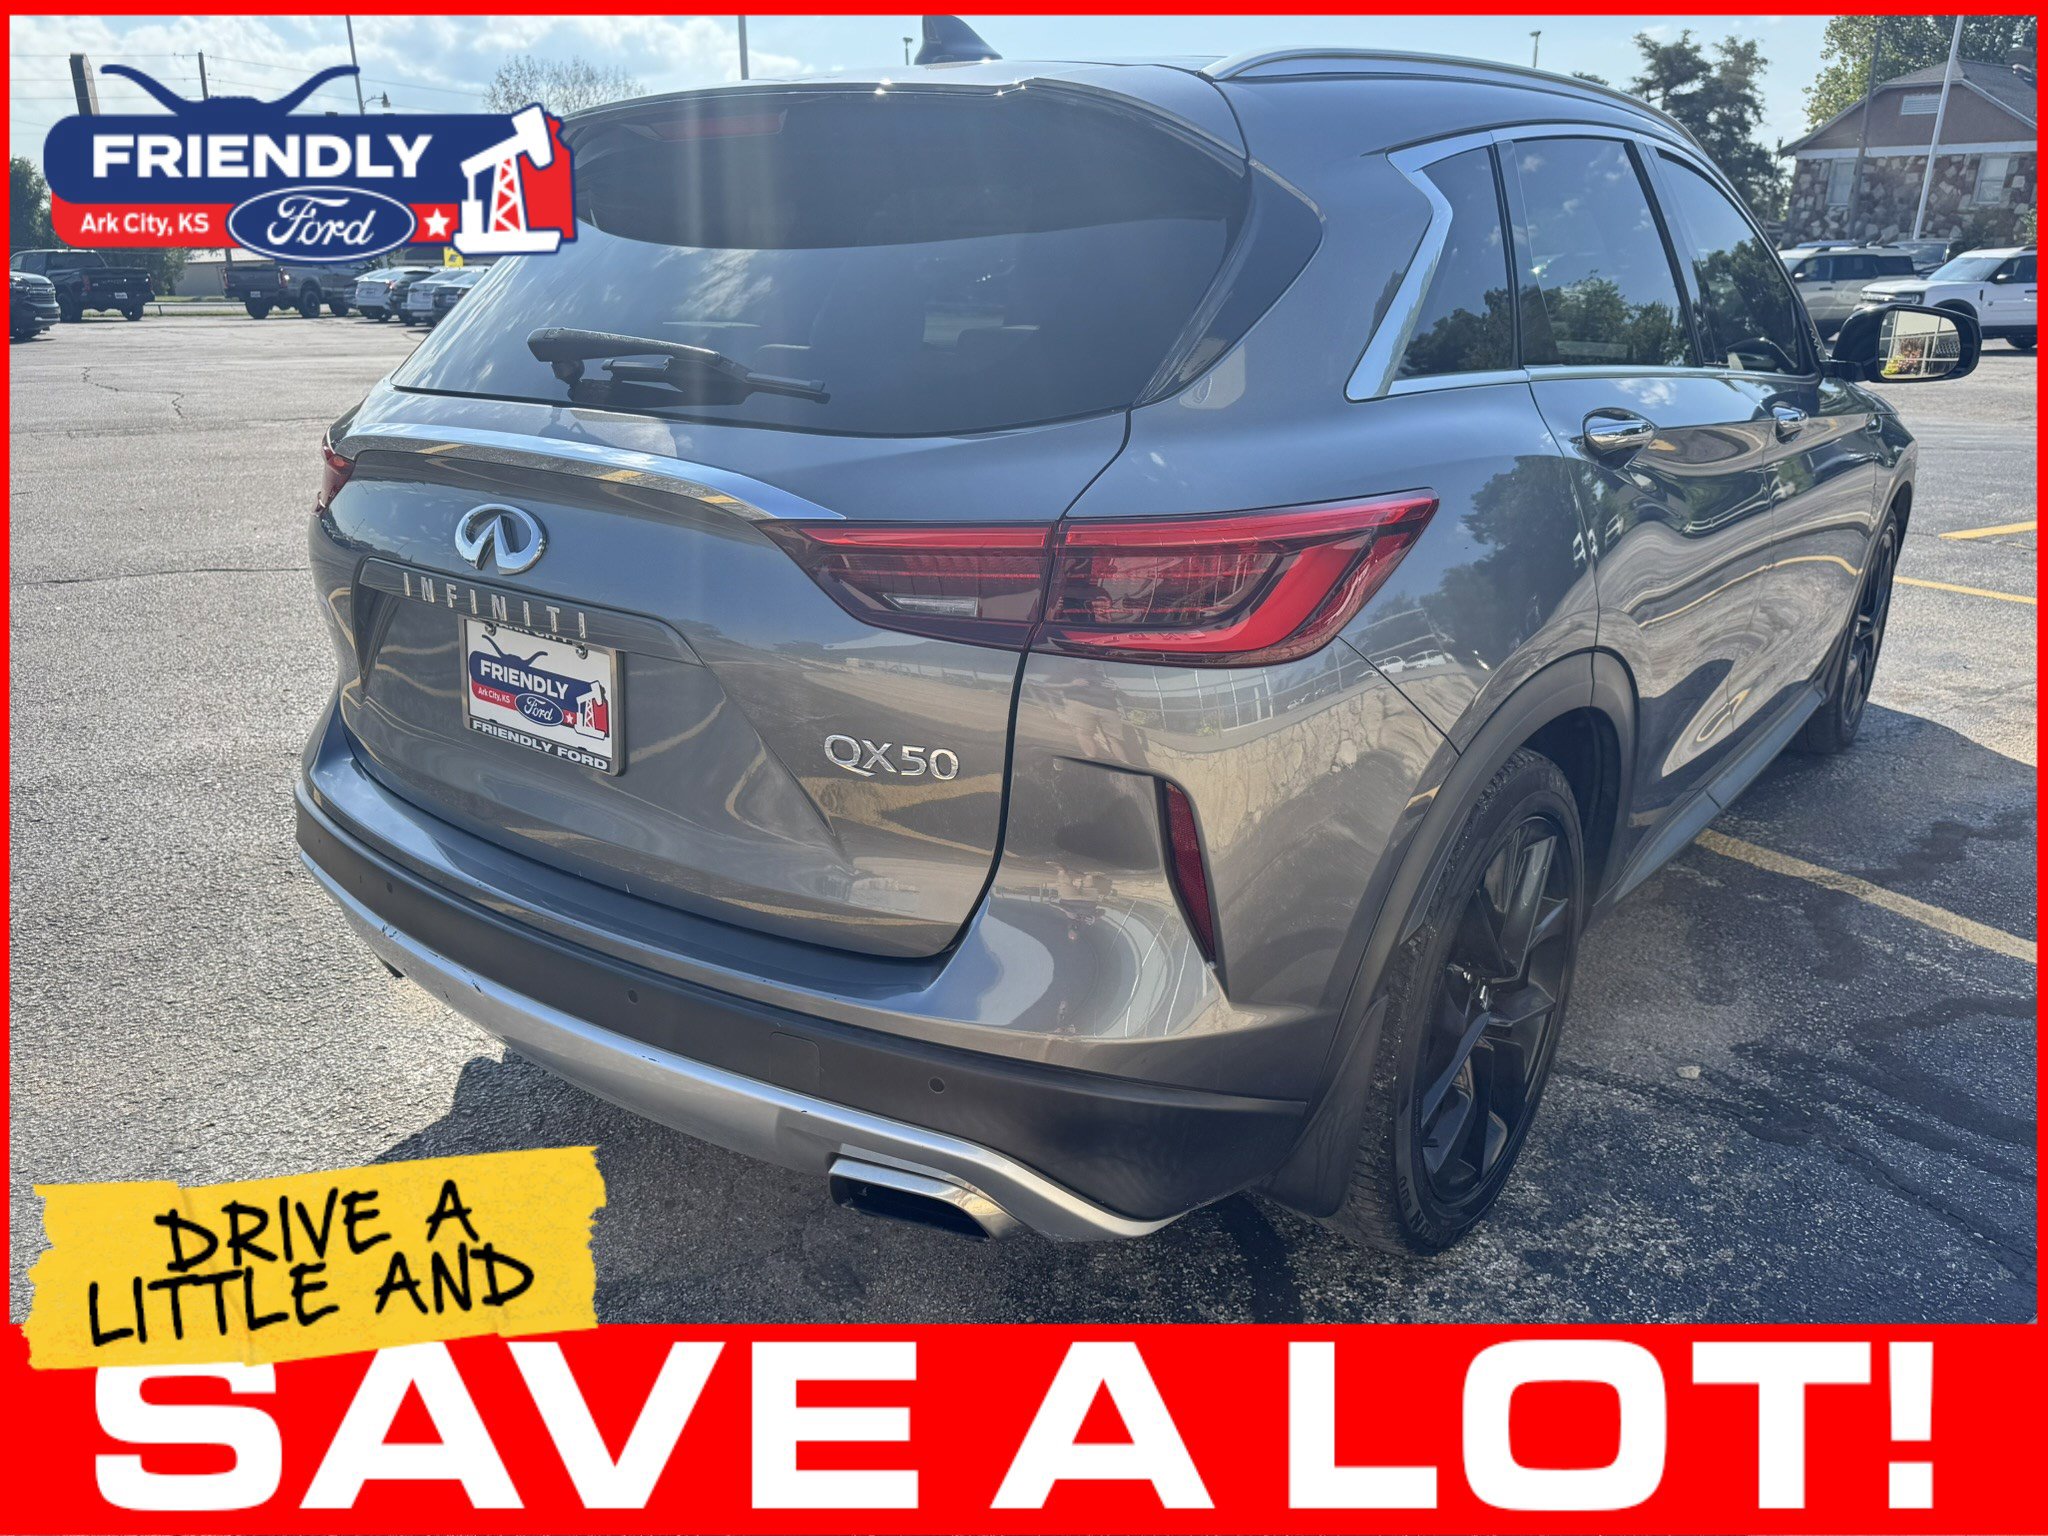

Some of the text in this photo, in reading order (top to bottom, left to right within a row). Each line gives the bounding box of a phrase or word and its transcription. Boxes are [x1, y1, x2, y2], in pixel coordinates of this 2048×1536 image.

[403, 572, 586, 639] INFINITI
[478, 686, 510, 703] Ark City, KS
[480, 659, 569, 700] FRIENDLY
[524, 697, 553, 721] Ford
[473, 720, 608, 771] FRIENDLY FORD
[824, 734, 959, 780] QX50
